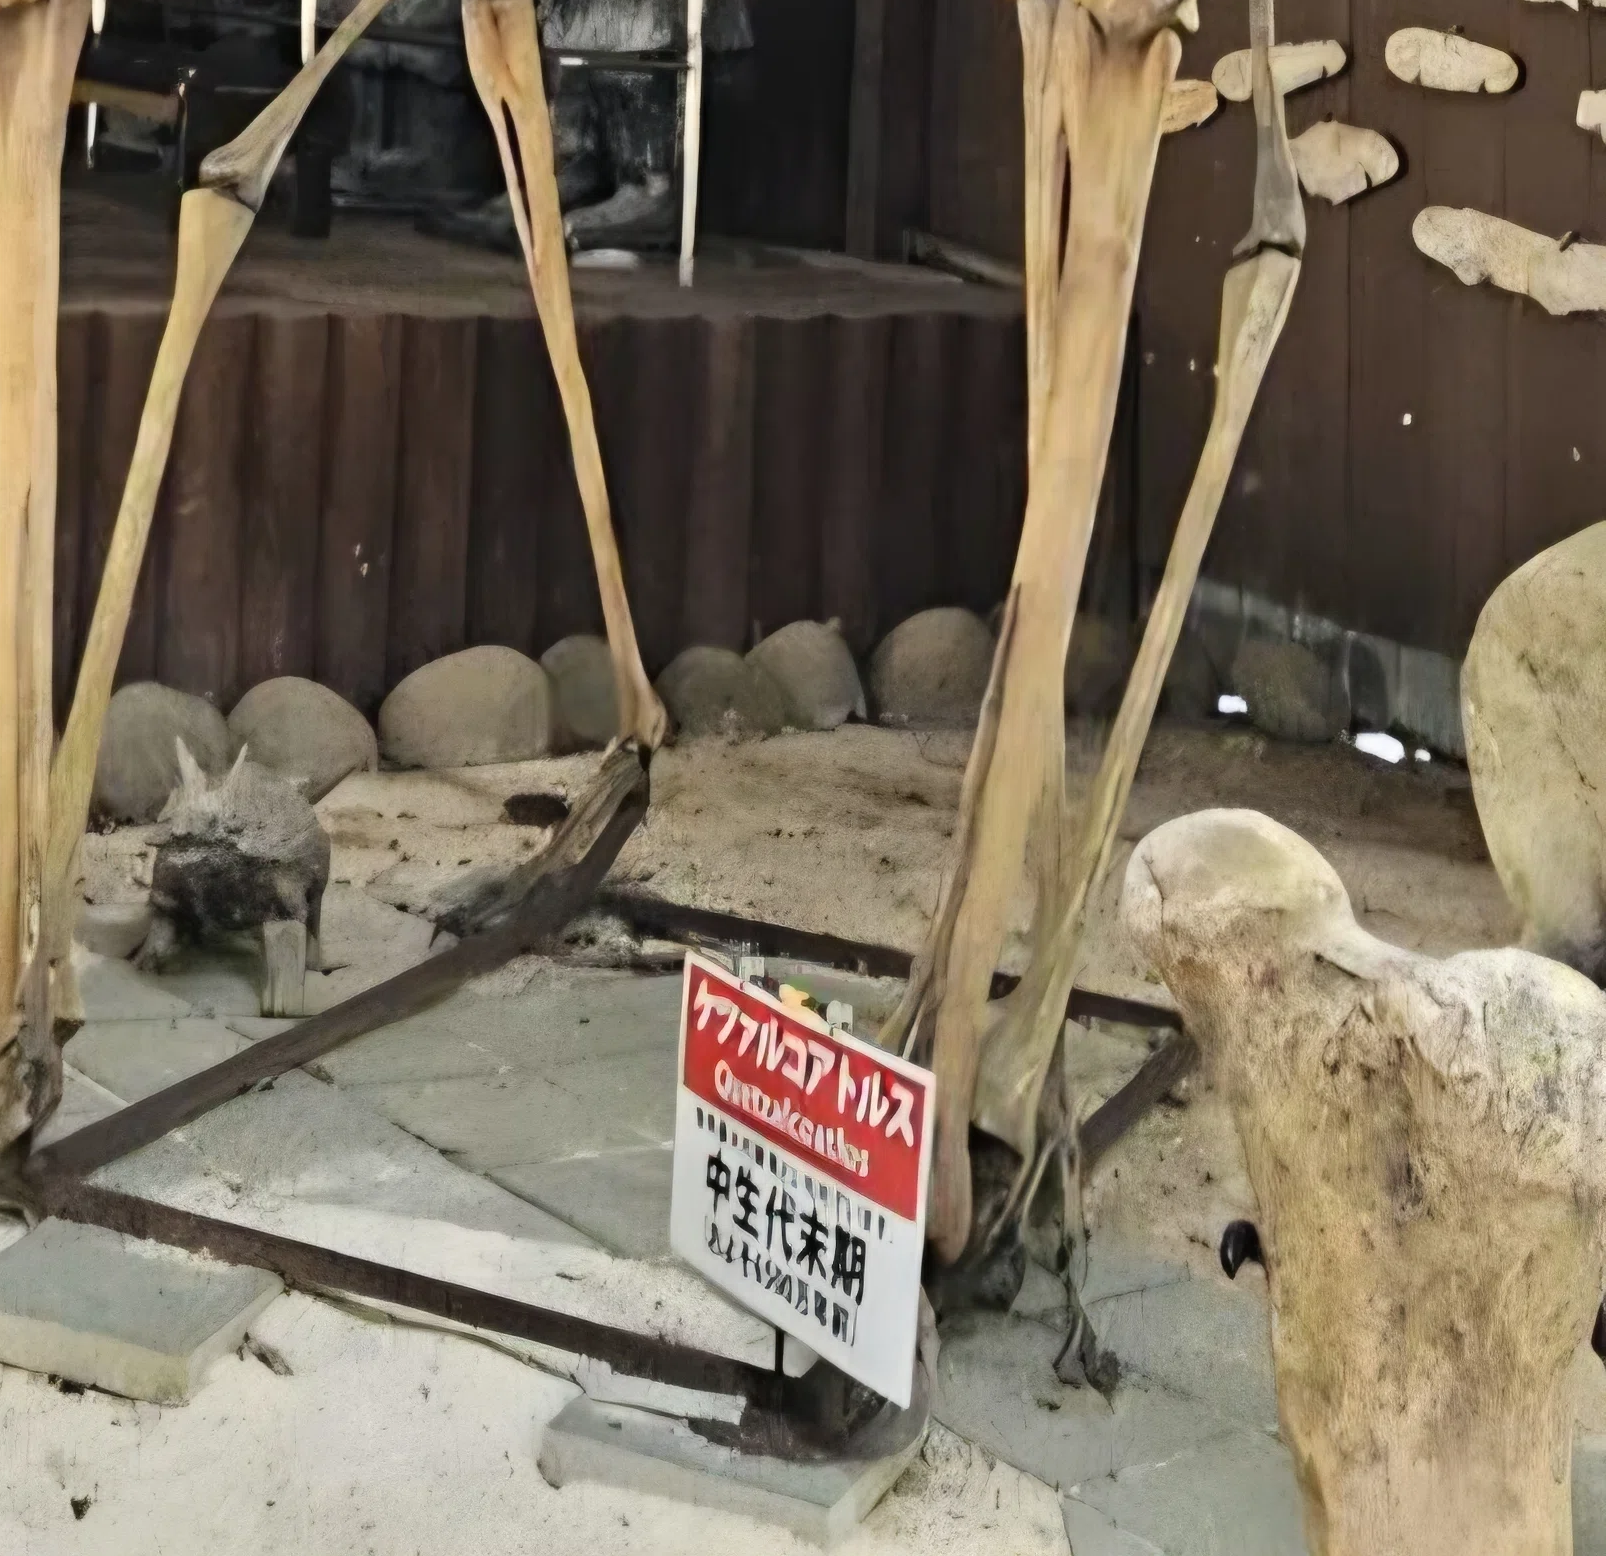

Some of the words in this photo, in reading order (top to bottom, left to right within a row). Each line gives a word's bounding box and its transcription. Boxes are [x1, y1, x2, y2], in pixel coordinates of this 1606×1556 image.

[706, 1148, 867, 1306] 中生代末期
